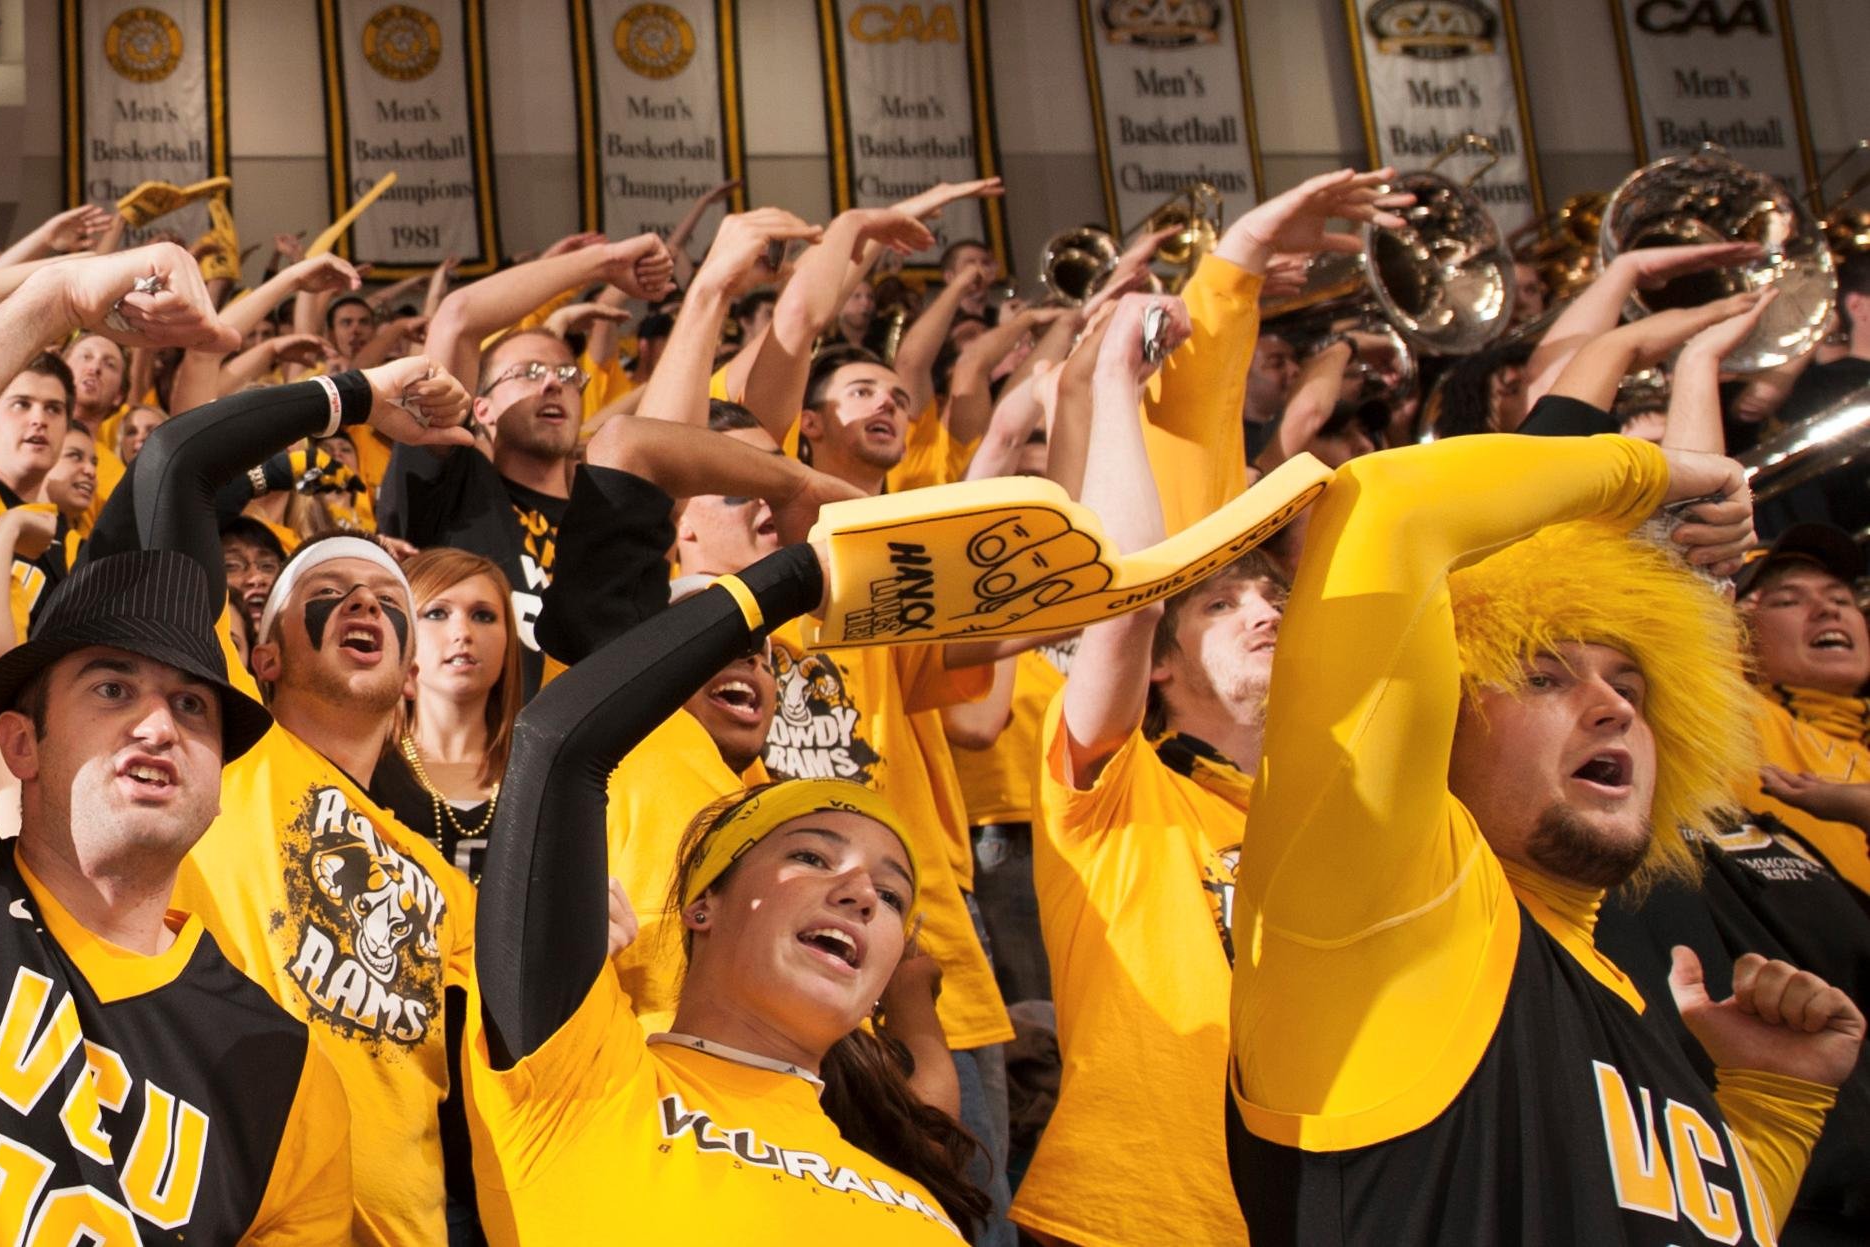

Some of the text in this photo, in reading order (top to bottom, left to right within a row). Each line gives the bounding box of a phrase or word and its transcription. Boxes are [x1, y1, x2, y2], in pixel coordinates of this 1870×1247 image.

[848, 3, 961, 44] CAA
[1637, 0, 1771, 37] CAA
[1133, 67, 1206, 97] Men's
[1407, 78, 1482, 108] Men's
[1674, 67, 1751, 97] Men's
[115, 98, 179, 122] Men's
[377, 100, 442, 123] Men's
[628, 96, 693, 120] Men's
[881, 96, 946, 119] Men's
[1119, 113, 1237, 145] Basketball
[1657, 117, 1783, 147] Basketball
[91, 139, 203, 162] Basketball
[354, 136, 466, 163] Basketball
[606, 133, 716, 161] Basketball
[858, 134, 974, 159] Basketball
[354, 177, 475, 205] Campions
[605, 173, 714, 205] Champio
[391, 225, 441, 248] 1981
[887, 542, 936, 637] HAVOC
[766, 705, 859, 749] OWDY
[764, 745, 860, 779] RAMS
[292, 924, 427, 1042] RAMS
